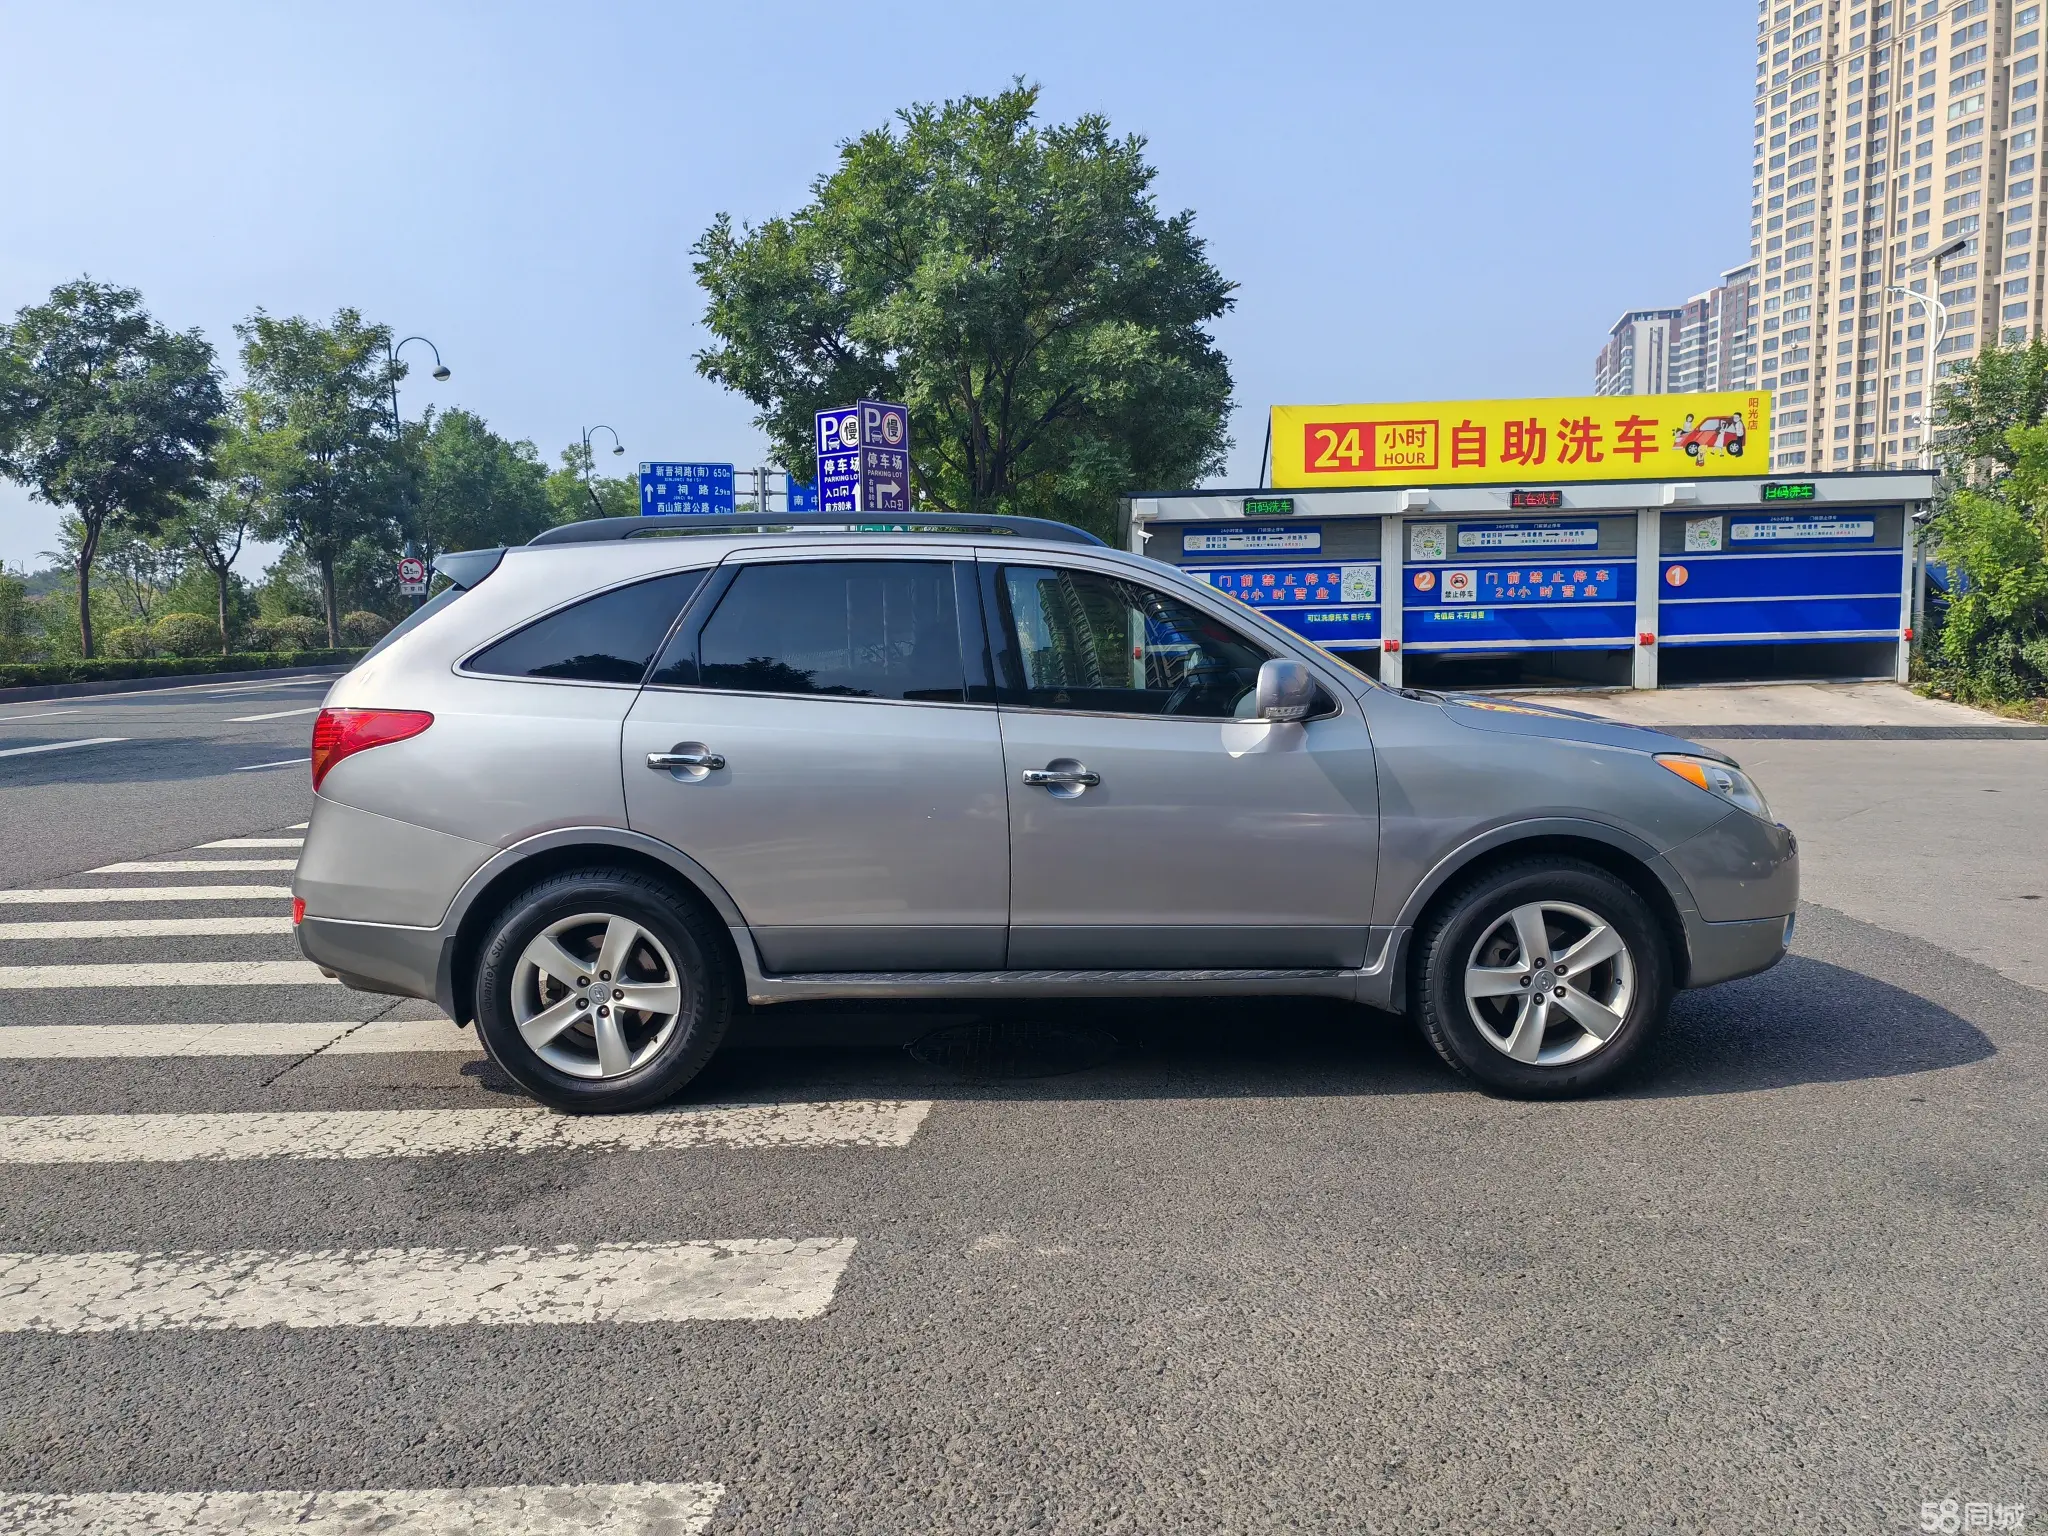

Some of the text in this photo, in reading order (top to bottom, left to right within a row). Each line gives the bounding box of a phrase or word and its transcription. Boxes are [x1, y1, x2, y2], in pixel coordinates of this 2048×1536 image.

[1748, 397, 1759, 430] 阳光店
[844, 422, 858, 440] 慢
[864, 407, 881, 443] P
[887, 417, 899, 438] 慢
[821, 417, 838, 452] P
[1383, 426, 1428, 450] 小时
[1451, 414, 1660, 470] 自助洗车
[1313, 428, 1364, 469] 24
[824, 457, 860, 475] 停车场
[867, 452, 903, 470] 停车场
[1383, 451, 1427, 466] HOUR
[656, 465, 731, 478] 新晋祠路(南) 650m
[824, 475, 850, 483] PARKING
[867, 469, 892, 478] PARKING
[825, 487, 840, 498] 入口
[656, 502, 710, 513] 西山旅游公路
[825, 501, 852, 512] 前方80米
[884, 499, 897, 509] 入口
[1245, 500, 1292, 514] 扫码洗车
[1218, 572, 1341, 588] 门前禁止停车
[1418, 571, 1432, 589] 2
[1485, 570, 1610, 585] 门前禁止停车
[1671, 566, 1681, 586] 1
[1444, 589, 1475, 599] 禁止停车
[1495, 585, 1598, 599] 24小时营业
[1350, 612, 1372, 621] 自行车
[491, 933, 508, 959] SUV
